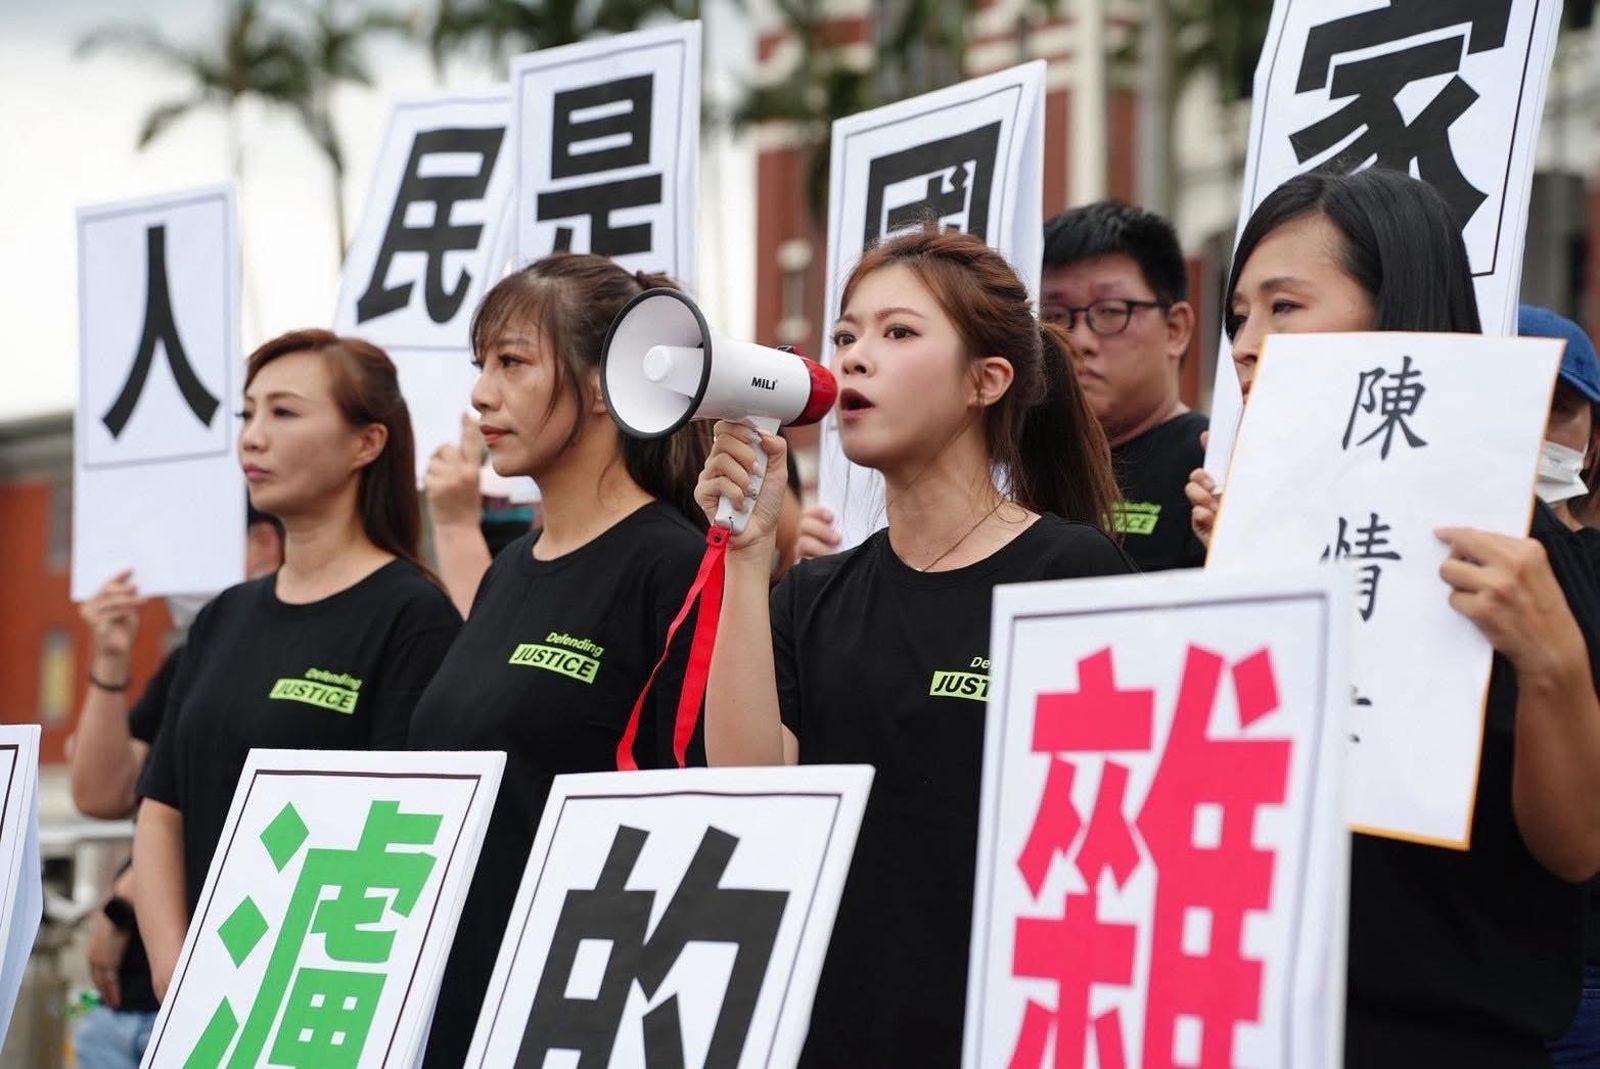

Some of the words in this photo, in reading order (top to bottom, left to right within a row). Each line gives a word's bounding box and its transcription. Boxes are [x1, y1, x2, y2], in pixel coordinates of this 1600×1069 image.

[537, 73, 662, 257] 是
[1288, 0, 1512, 232] 家
[357, 126, 506, 325] 民
[102, 225, 221, 440] 人
[751, 376, 776, 391] MILI
[545, 631, 604, 658] Defending
[1322, 355, 1429, 742] 陳情
[275, 682, 354, 709] JUSTICE
[514, 647, 596, 678] JUSTICE
[933, 674, 990, 698] JUST
[183, 800, 443, 1069] 濾
[515, 825, 790, 1069] 的
[1006, 643, 1293, 1069] 雜
